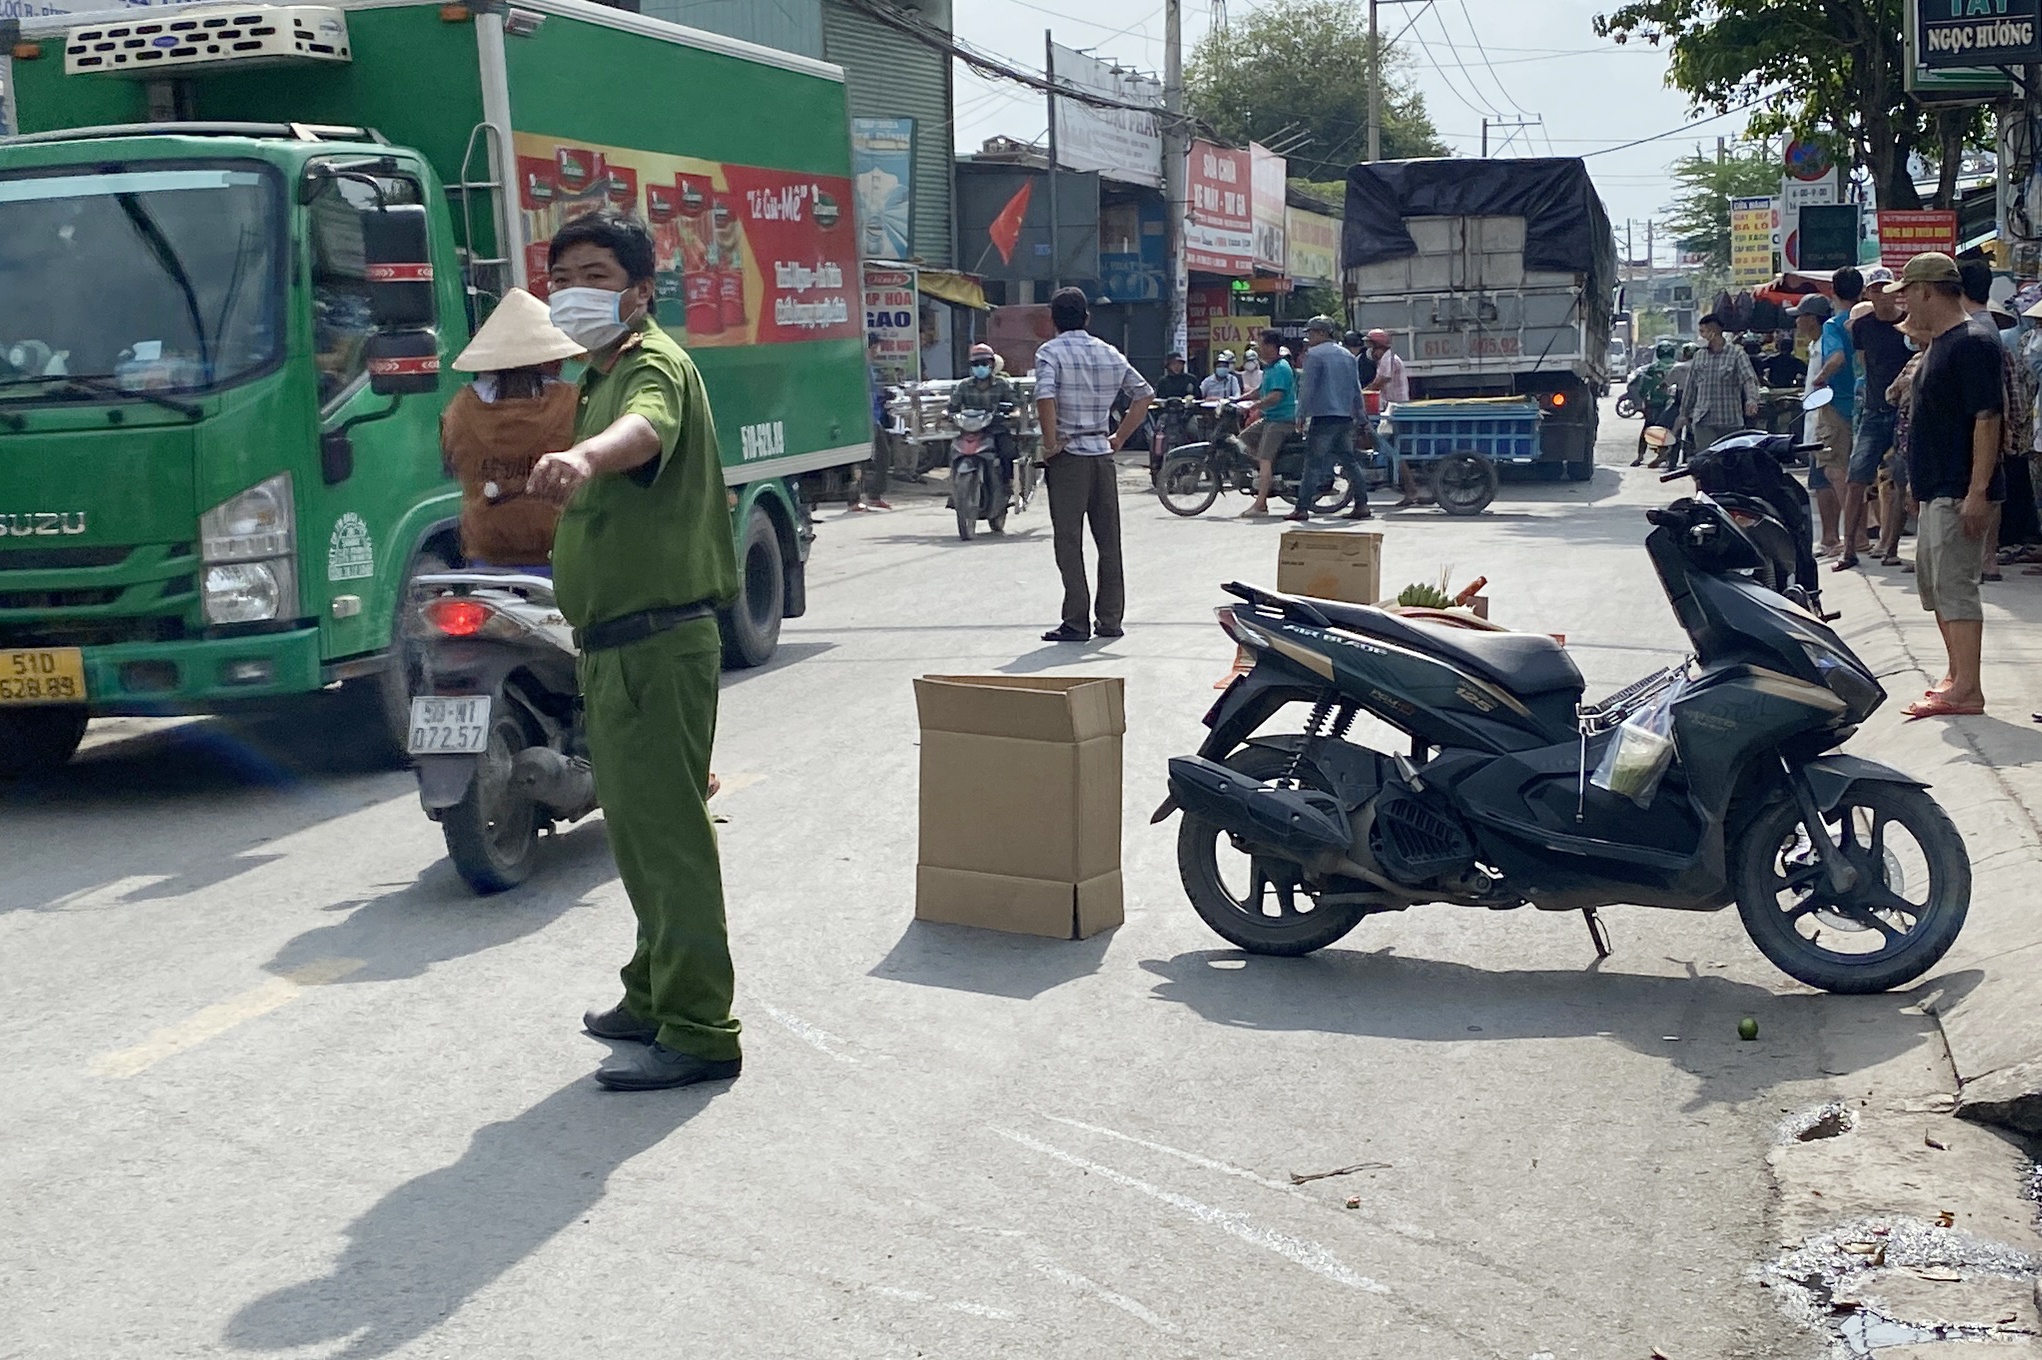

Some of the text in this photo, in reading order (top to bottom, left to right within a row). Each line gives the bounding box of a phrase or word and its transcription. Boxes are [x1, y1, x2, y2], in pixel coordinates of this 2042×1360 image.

[1928, 27, 1973, 54] NGỌC
[12, 653, 55, 675] 51D
[1455, 687, 1494, 712] 125
